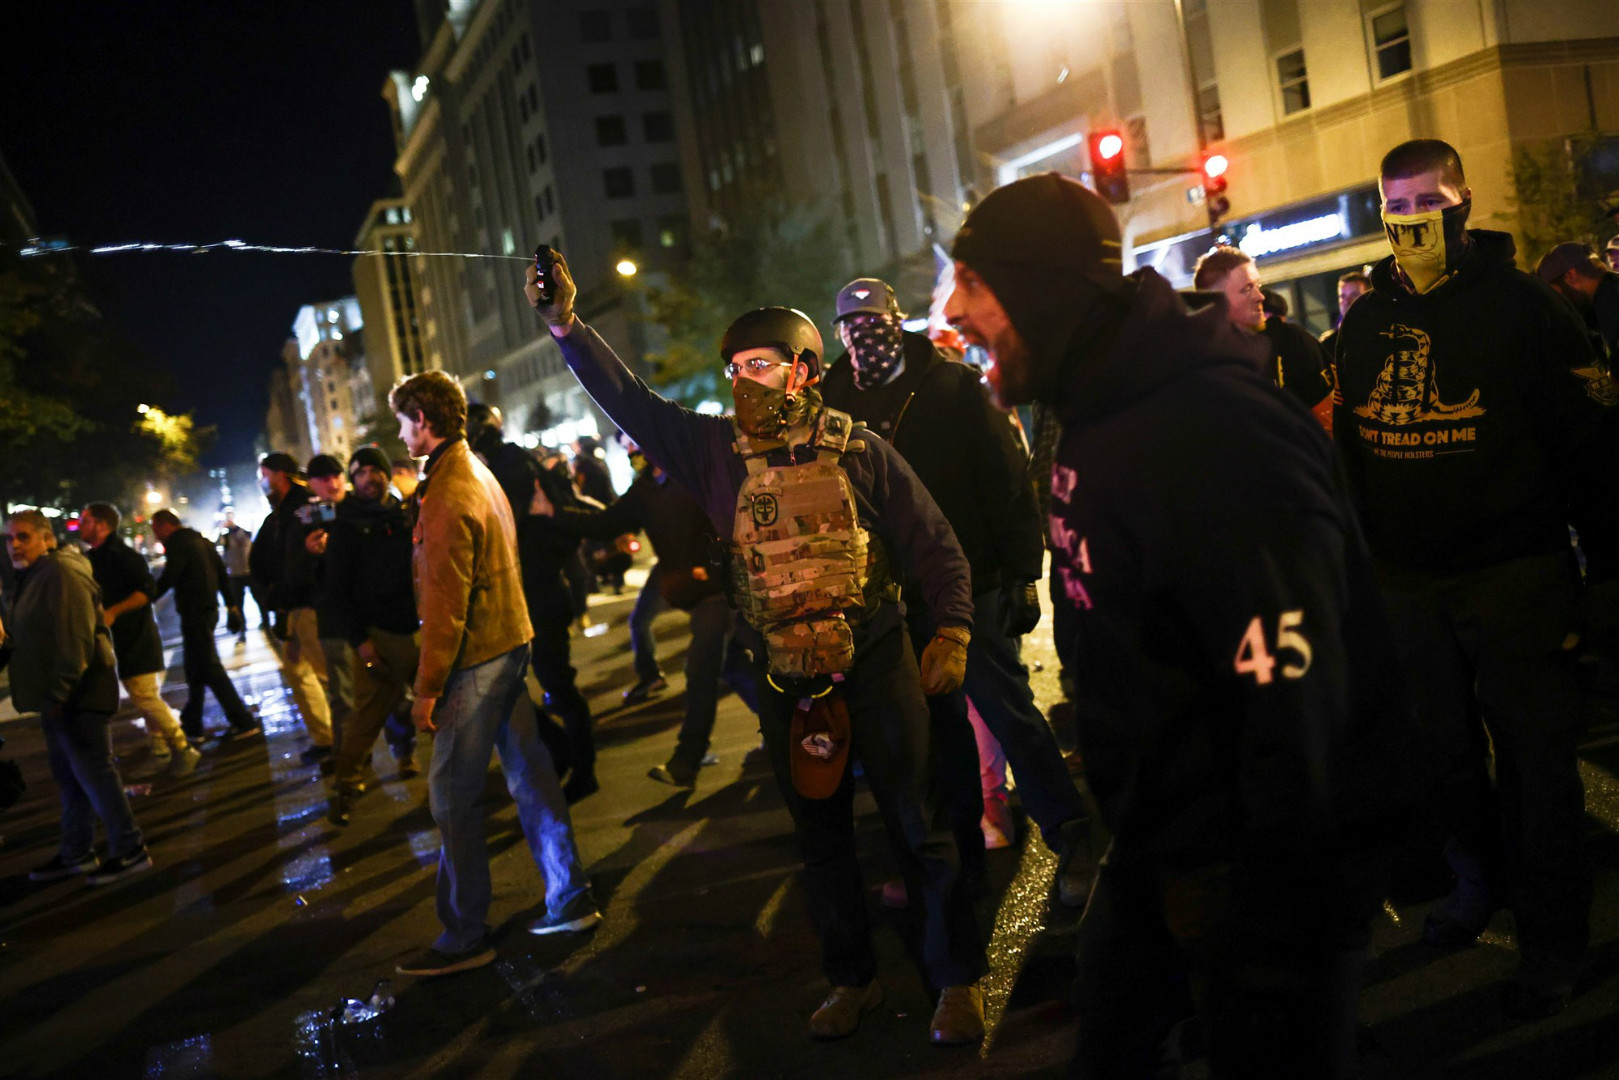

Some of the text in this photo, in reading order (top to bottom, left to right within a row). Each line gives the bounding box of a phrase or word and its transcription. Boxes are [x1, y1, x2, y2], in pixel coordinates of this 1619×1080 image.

[1381, 432, 1420, 446] TREAD
[1424, 430, 1448, 445] ON
[1452, 427, 1476, 441] ME
[1404, 450, 1434, 459] HOLSTERS
[1234, 609, 1312, 684] 45
